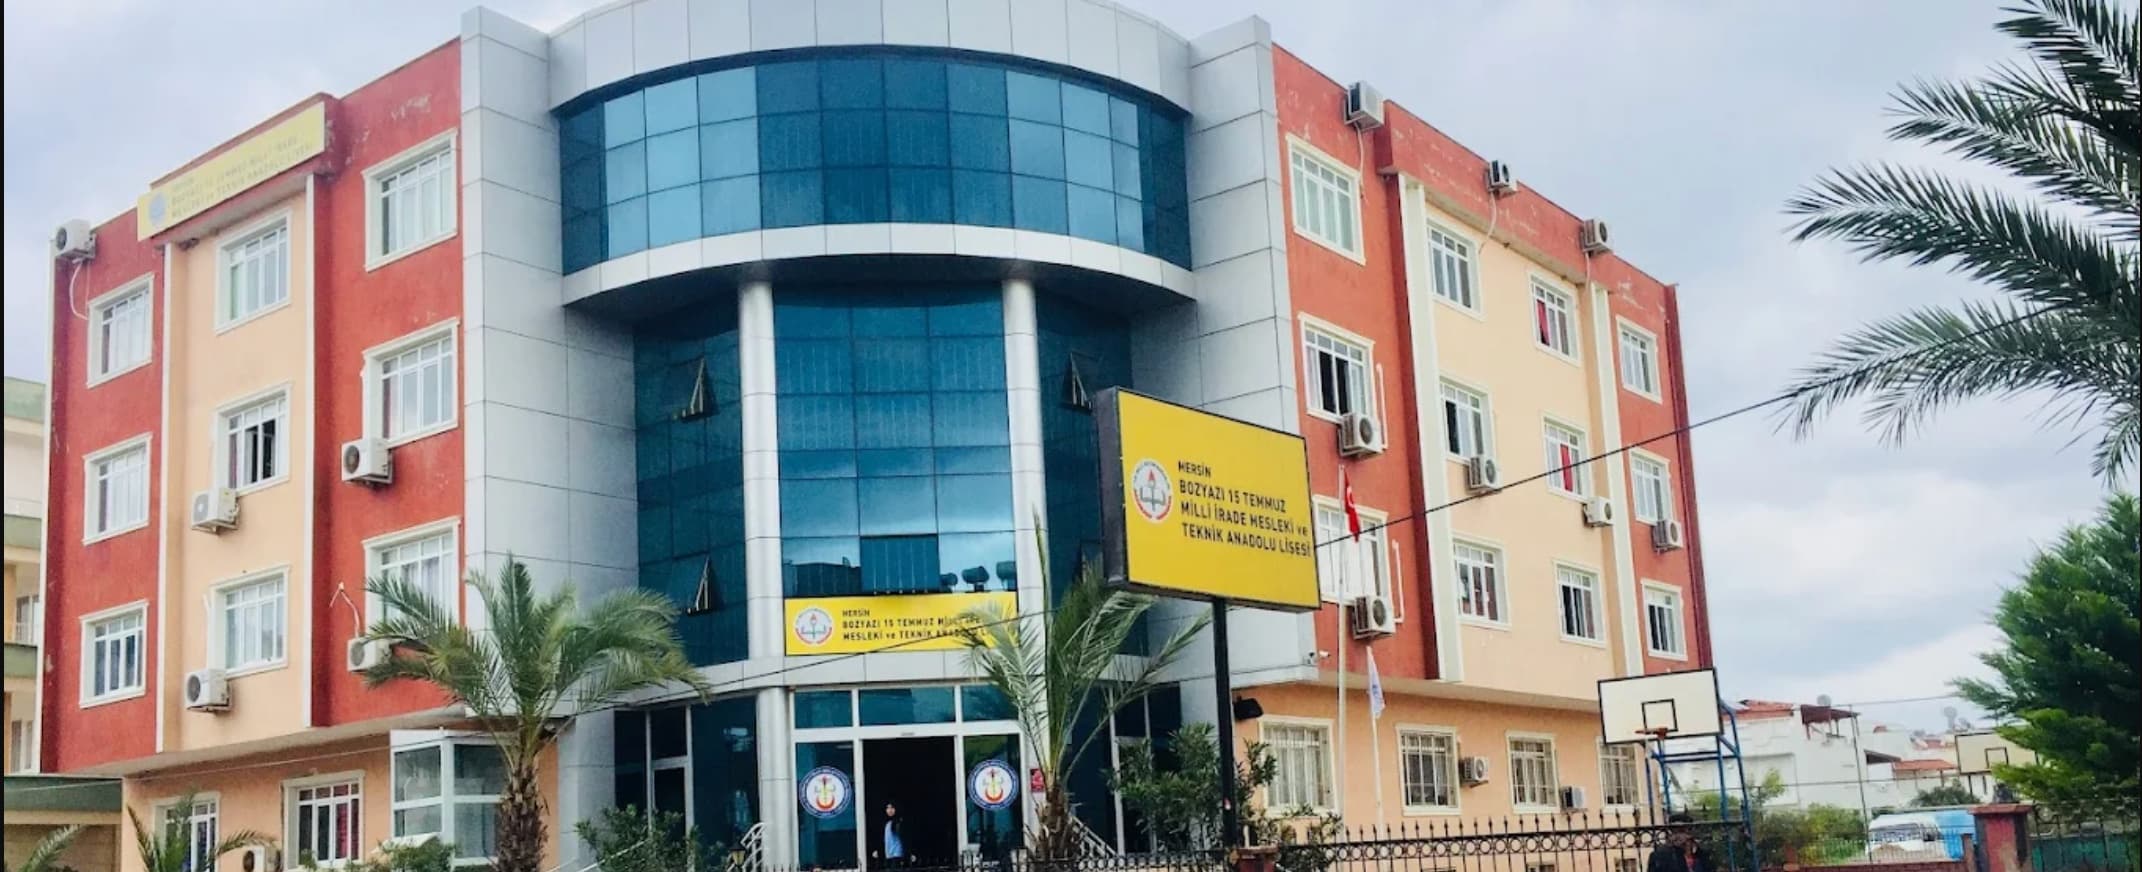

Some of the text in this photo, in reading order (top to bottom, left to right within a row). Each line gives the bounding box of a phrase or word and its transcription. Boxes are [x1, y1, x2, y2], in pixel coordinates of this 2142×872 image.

[1178, 460, 1211, 478] MERSİN
[1179, 479, 1286, 513] BOZYAZI 15 TEMMUZ
[1181, 499, 1308, 536] MİLLİ İRADE MESLEKİ ve
[1182, 522, 1312, 558] TEKNİK ANADOLU LİSESİ
[897, 617, 933, 627] TEMMUZ
